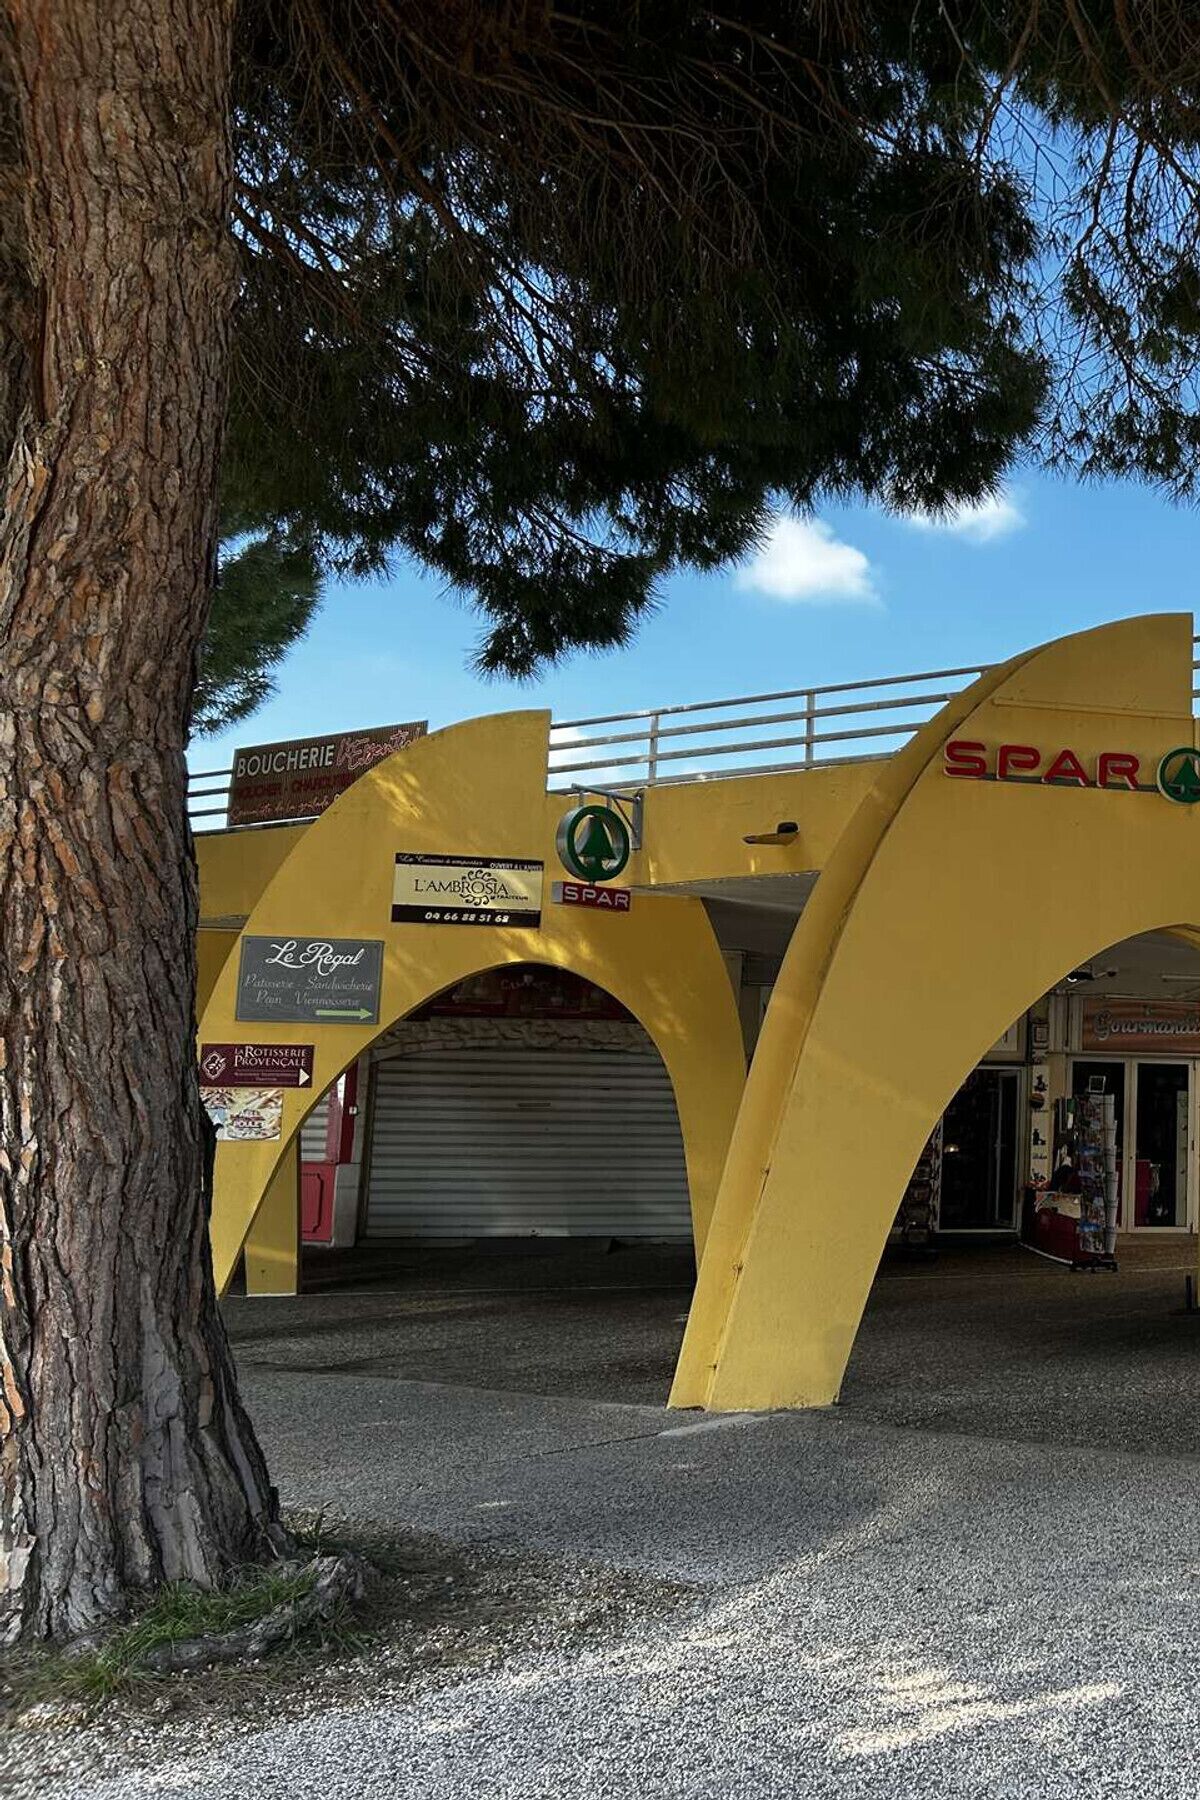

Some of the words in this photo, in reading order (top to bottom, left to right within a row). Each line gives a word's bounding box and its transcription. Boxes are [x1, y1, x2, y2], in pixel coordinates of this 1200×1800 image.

[236, 744, 335, 777] BOUCHERIE
[944, 740, 1139, 790] SPAR
[414, 879, 509, 895] L'AMBROSIA
[564, 885, 628, 908] SPAR
[425, 911, 439, 920] 04
[443, 912, 458, 920] 66
[478, 914, 490, 922] 51
[265, 940, 305, 969] Le
[299, 942, 365, 976] Regal
[256, 990, 282, 1004] Pain
[234, 1047, 244, 1055] LA
[244, 1045, 306, 1058] ROTISSERIE
[234, 1055, 306, 1068] PROVENÇALE
